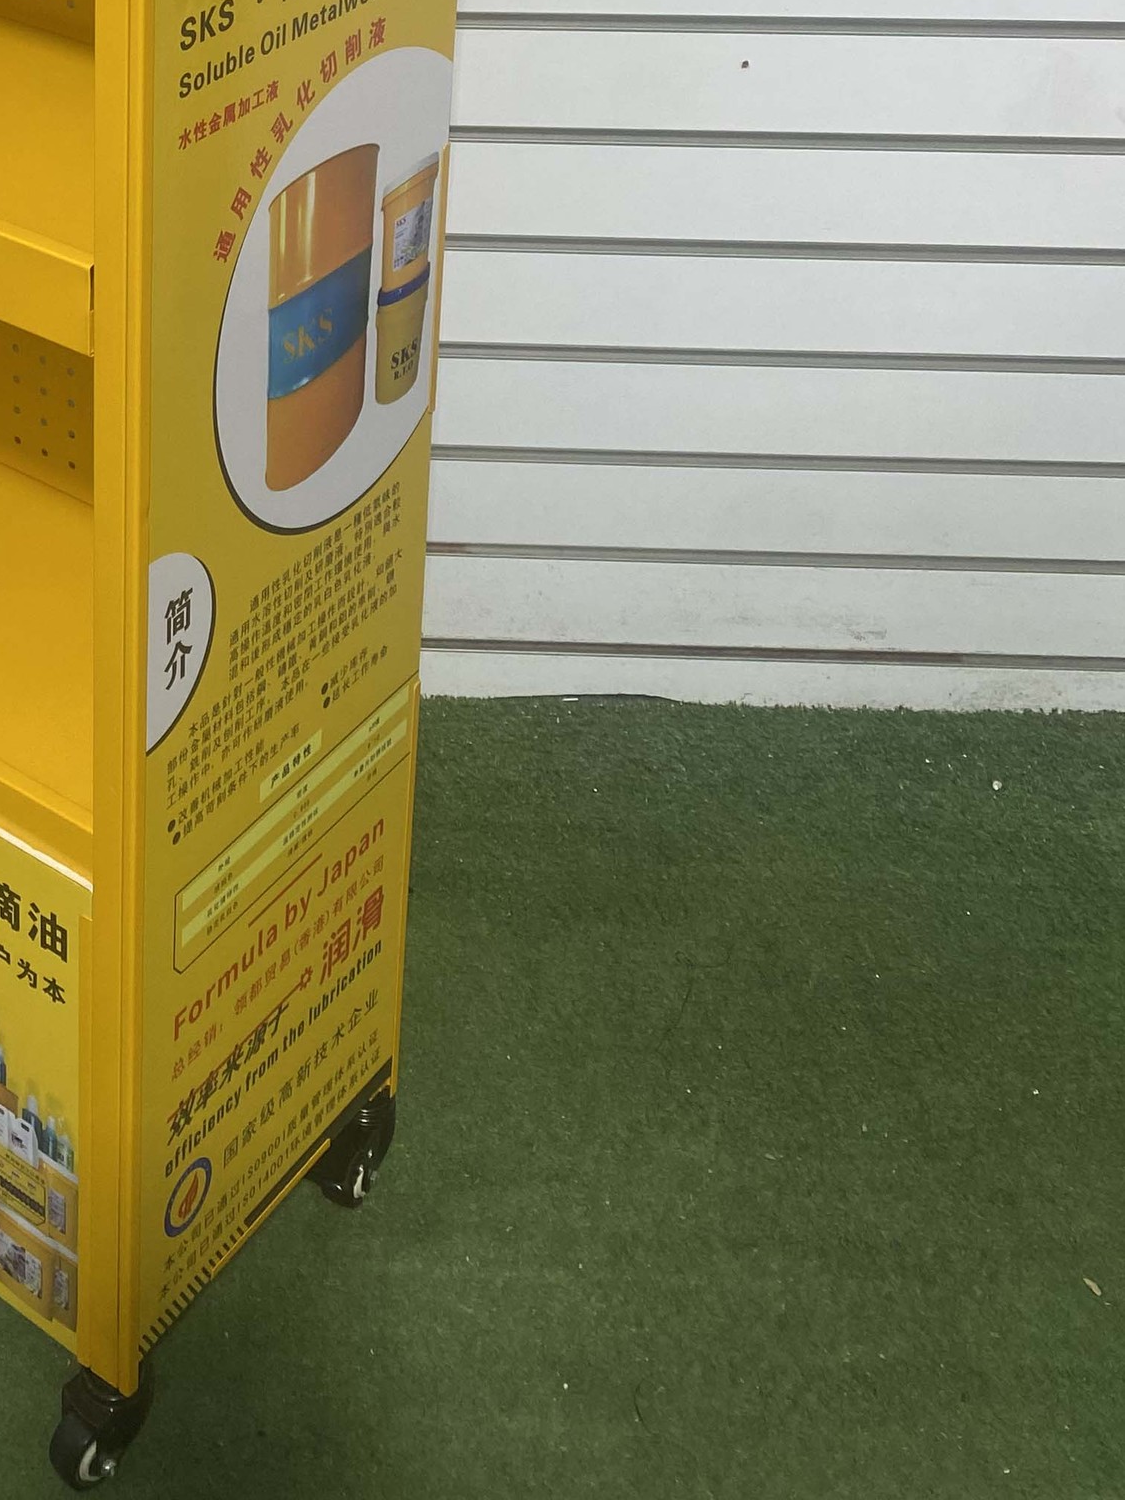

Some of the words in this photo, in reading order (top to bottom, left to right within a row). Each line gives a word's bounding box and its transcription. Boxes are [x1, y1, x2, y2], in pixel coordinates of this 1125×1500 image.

[179, 45, 255, 99] Soluble
[260, 24, 287, 57] Oil
[177, 80, 280, 151] 水性金属加工液
[282, 308, 336, 364] SKS
[390, 336, 417, 370] SKS
[164, 587, 193, 691] 简介
[172, 913, 278, 1043] Formula
[284, 886, 312, 931] by
[316, 813, 385, 900] Japan
[164, 1081, 241, 1180] efficiency
[244, 1042, 279, 1095] from
[282, 1013, 305, 1055] the
[308, 933, 382, 1028] lubrication
